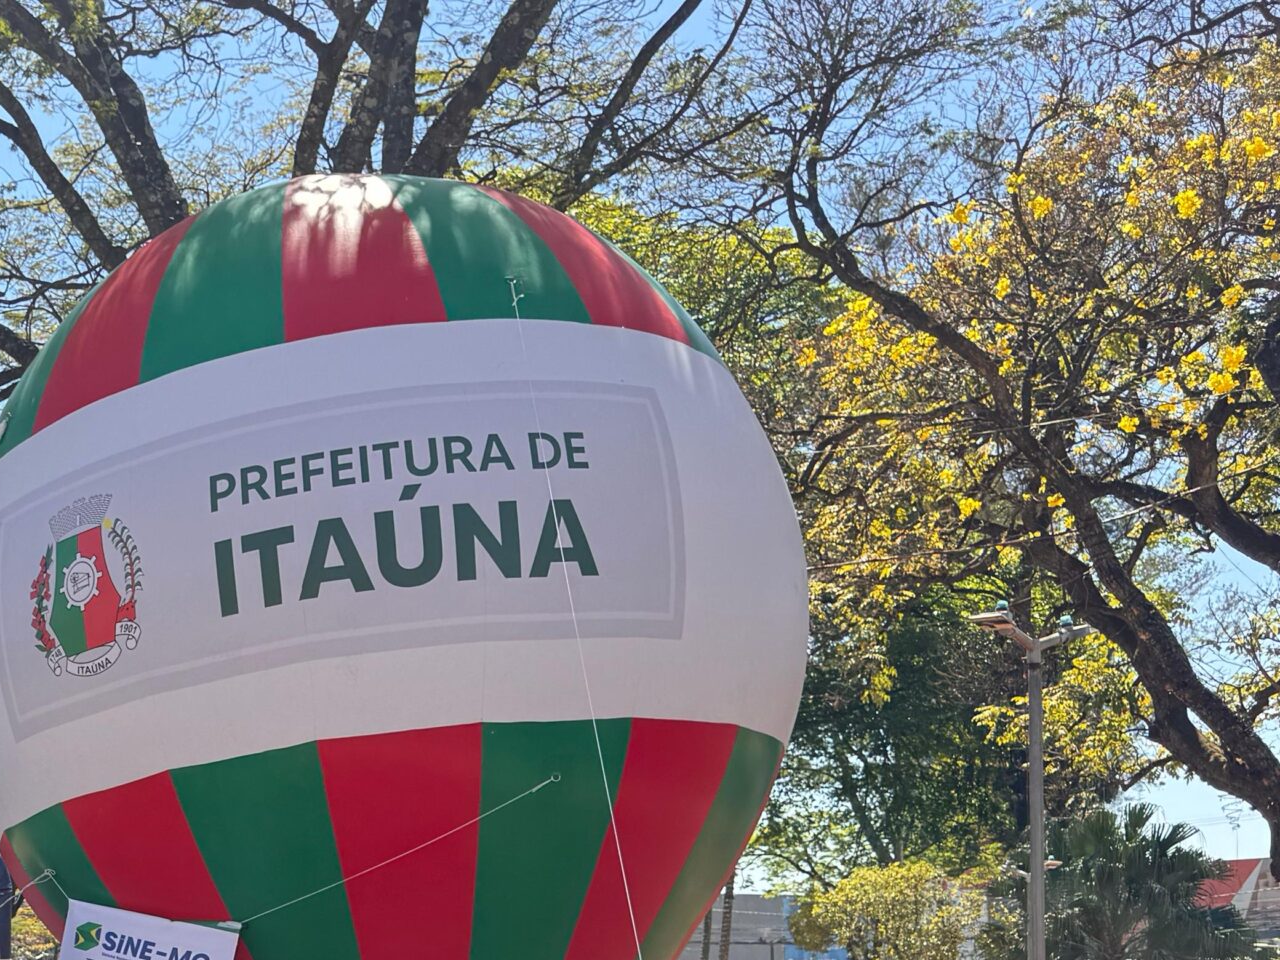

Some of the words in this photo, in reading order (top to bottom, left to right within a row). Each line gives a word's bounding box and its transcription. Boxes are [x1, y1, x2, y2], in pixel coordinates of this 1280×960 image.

[208, 433, 516, 513] PREFEITURA
[527, 431, 590, 470] DE
[213, 483, 600, 619] ITAÚNA
[119, 623, 138, 634] 1901
